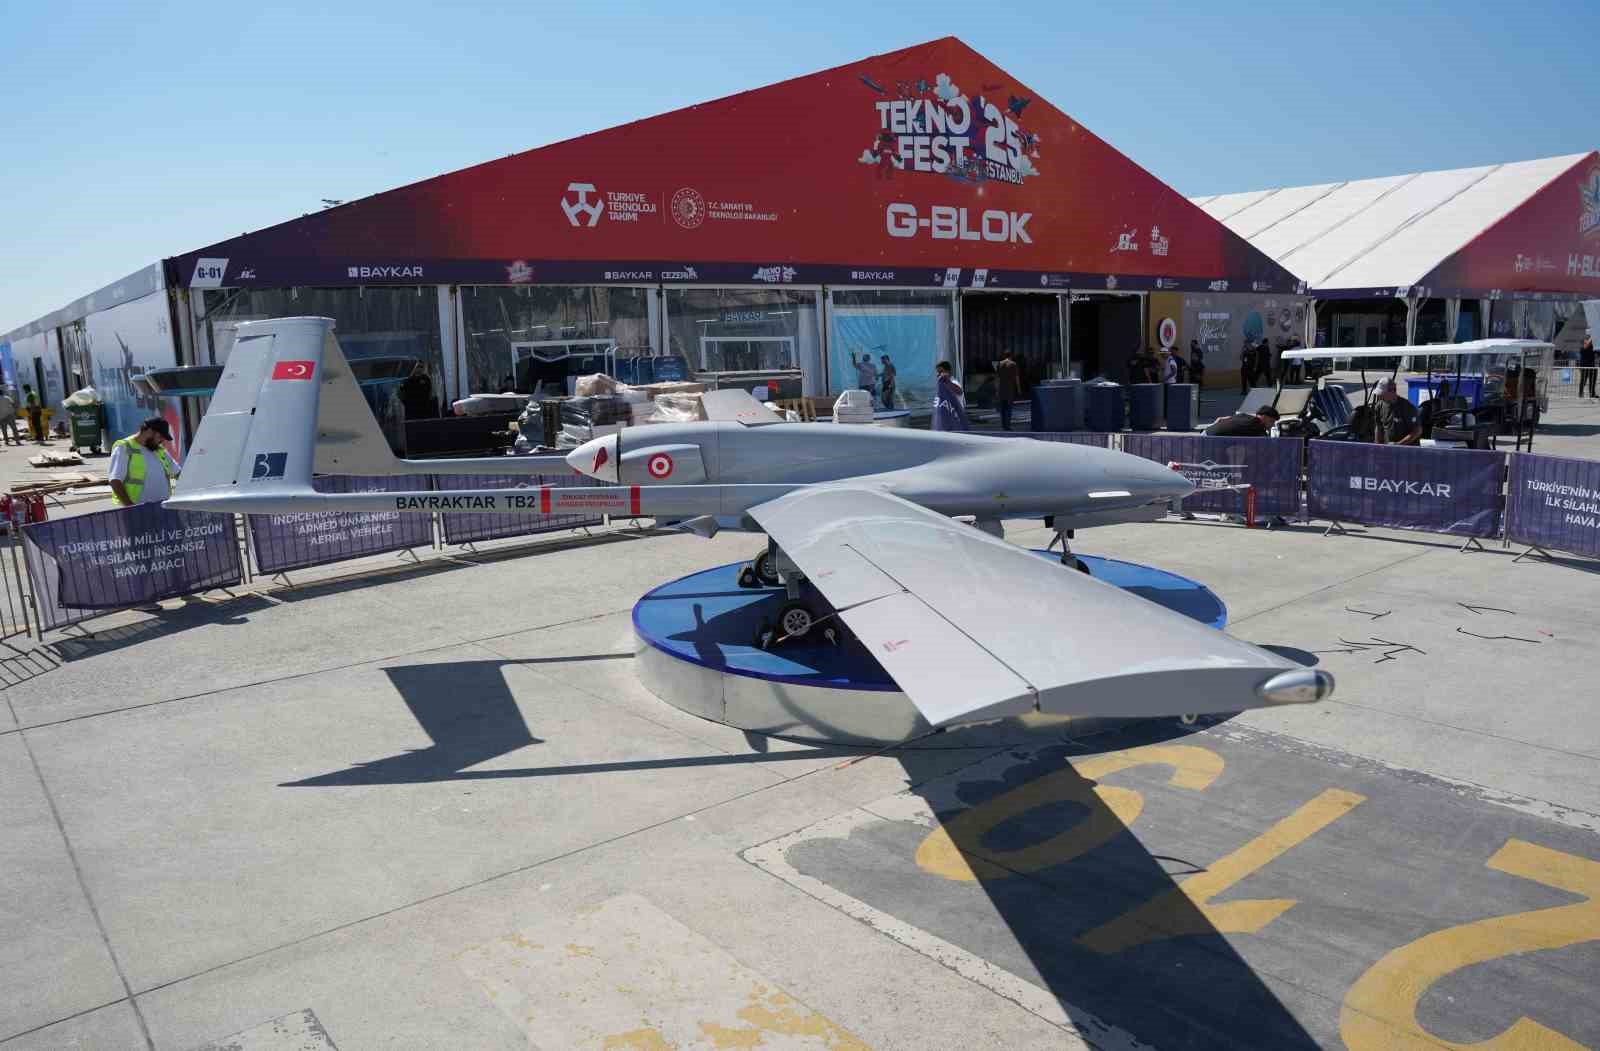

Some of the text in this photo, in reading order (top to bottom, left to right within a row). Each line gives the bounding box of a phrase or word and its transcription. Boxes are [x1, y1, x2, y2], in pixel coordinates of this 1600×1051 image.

[875, 95, 971, 135] TEKNO
[898, 136, 970, 174] FEST
[887, 203, 1033, 244] G-BLOK
[198, 266, 222, 279] G-01
[360, 266, 423, 278] BAYKAR
[612, 271, 653, 279] BAYKAR
[857, 271, 895, 280] BAYKAR
[1183, 471, 1242, 480] AYRAKTAR
[1364, 477, 1452, 498] BAYKAR
[1527, 479, 1591, 499] TÜRKİYE'NİN
[396, 488, 536, 511] BAYRAKTAR TB2
[1545, 494, 1562, 507] İLK
[297, 512, 400, 535] ARMED UNMANNED
[1564, 513, 1595, 529] HAVA
[135, 529, 165, 546] MİLLİ
[168, 529, 183, 540] VE
[184, 521, 224, 537] ÖZGÜN
[310, 523, 393, 546] AERIAL VEHICLE
[107, 550, 151, 565] SİLAHLI
[154, 540, 207, 556] İNSANSIZ
[114, 557, 186, 578] HAVA ARACI
